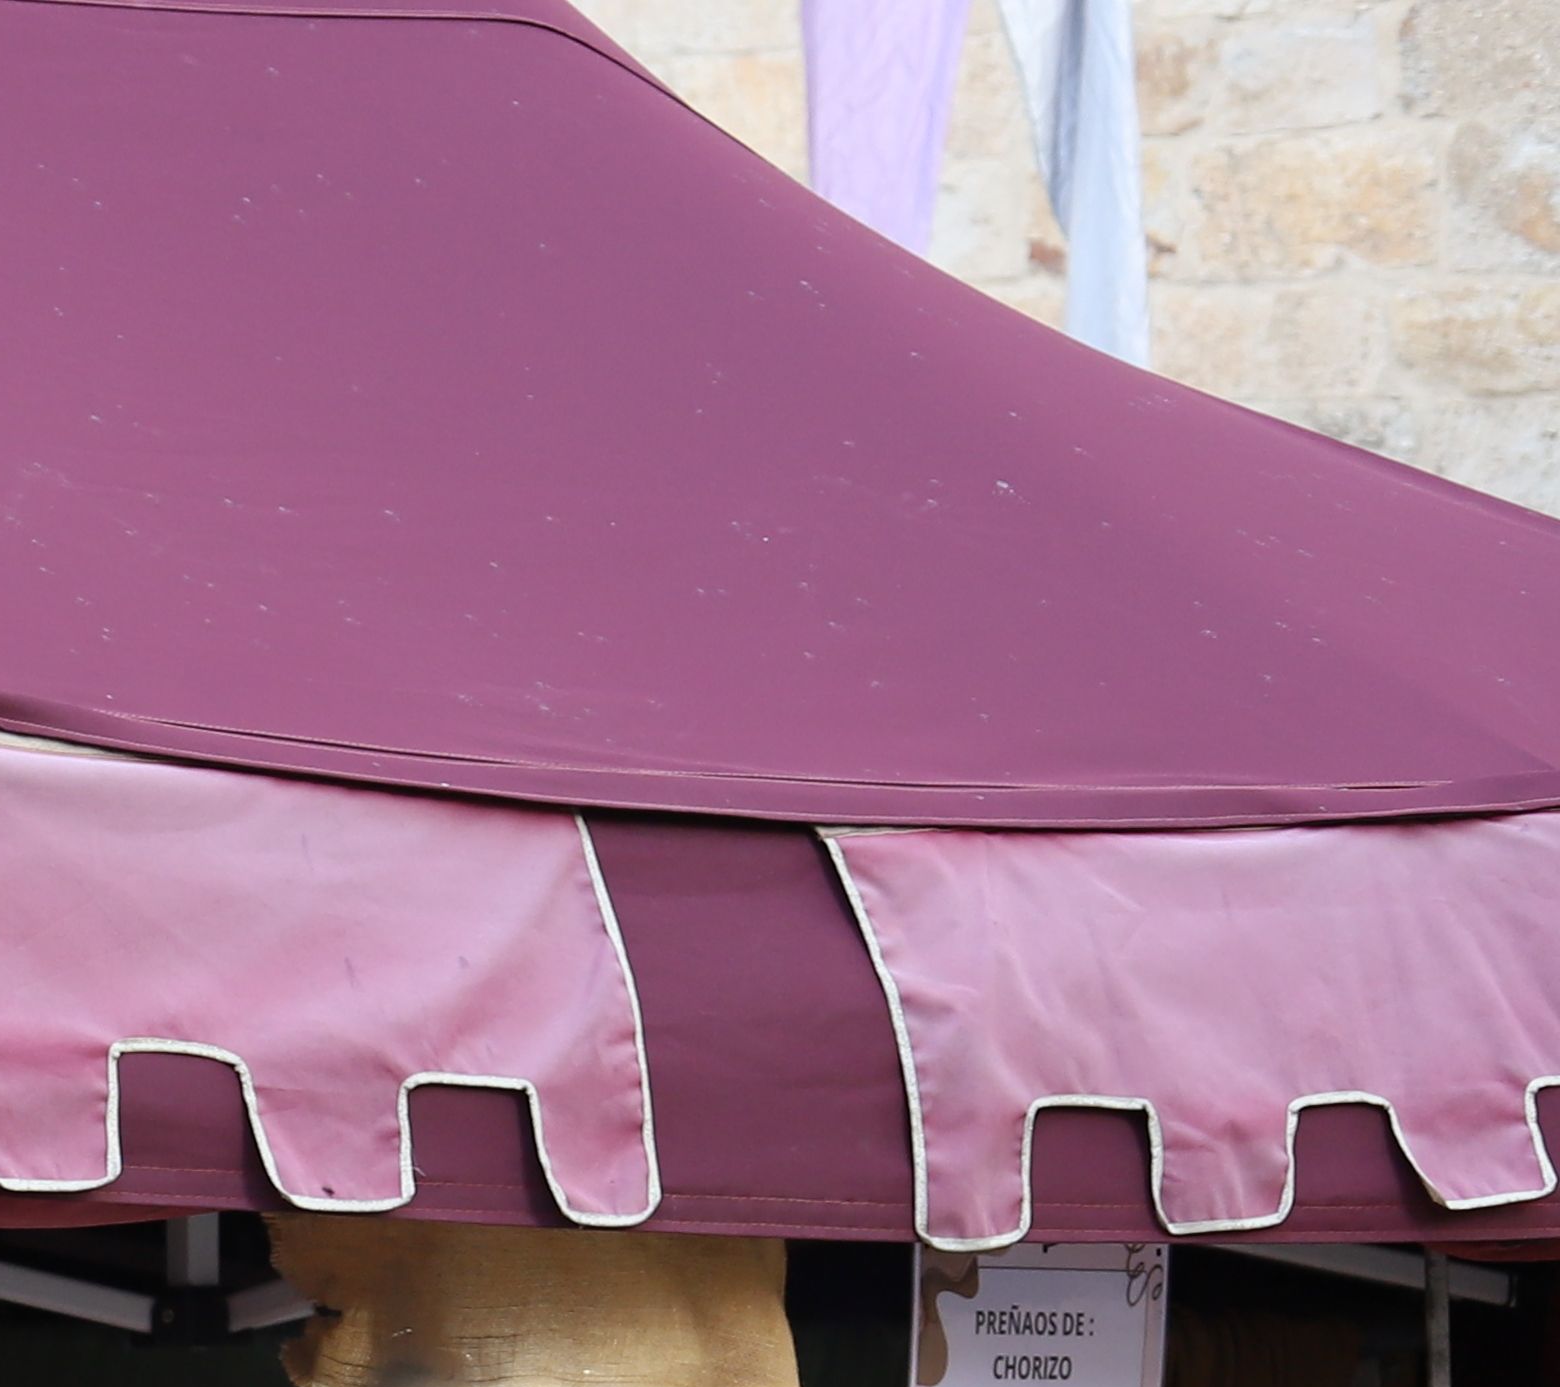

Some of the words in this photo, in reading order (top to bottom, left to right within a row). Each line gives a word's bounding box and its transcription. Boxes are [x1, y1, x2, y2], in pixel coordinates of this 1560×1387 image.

[975, 1304, 1058, 1337] PREÑAOS
[1062, 1311, 1085, 1337] DE
[992, 1354, 1073, 1381] CHORIZO
